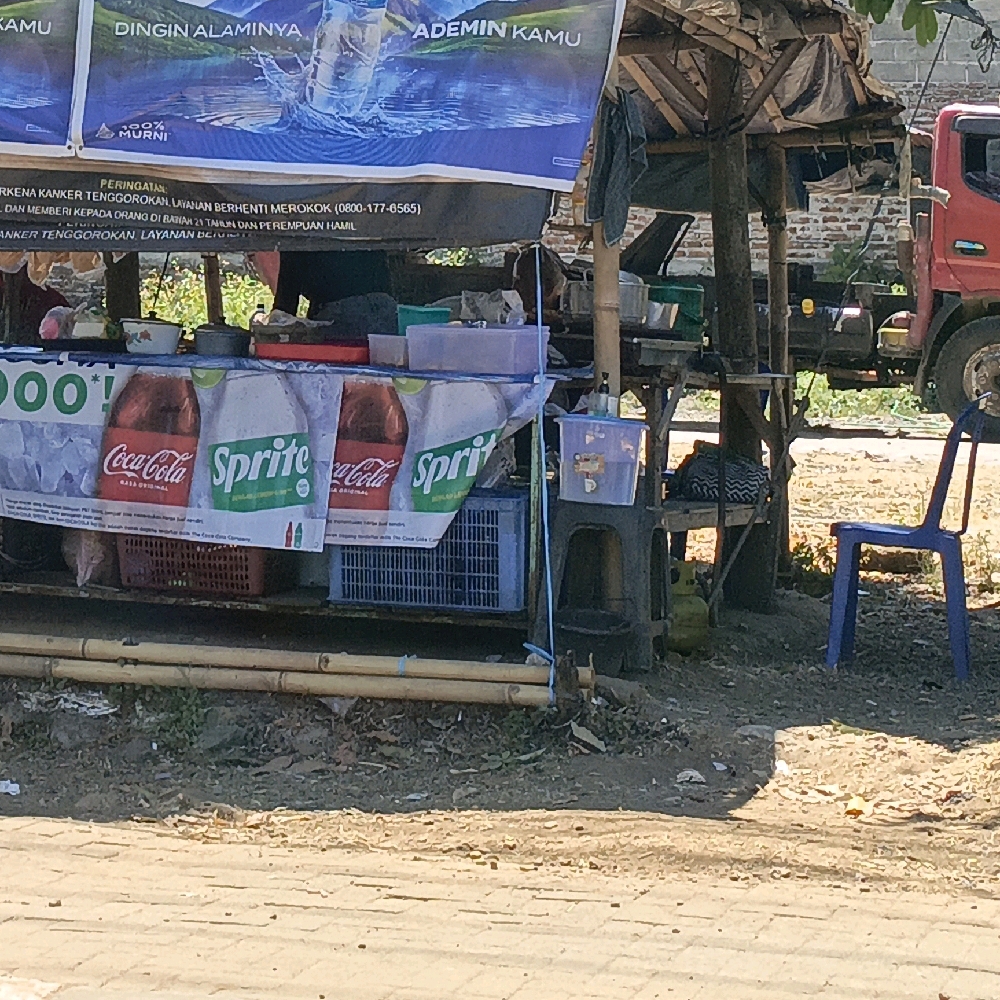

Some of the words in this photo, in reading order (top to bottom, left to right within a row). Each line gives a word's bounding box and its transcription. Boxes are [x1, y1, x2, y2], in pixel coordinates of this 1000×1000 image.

[114, 22, 189, 38] DINGIN
[192, 21, 303, 39] ALAMINYA
[412, 19, 508, 40] ADEMIN
[511, 26, 582, 47] KAMU
[118, 130, 168, 142] MURNI
[38, 188, 83, 201] KANKER
[214, 202, 268, 215] BERHENTI
[270, 203, 332, 215] MEROKOK
[334, 202, 422, 216] (0800-177-6565)
[4, 203, 25, 213] DAN
[27, 205, 72, 216] MEMBERI
[73, 207, 113, 219] KEPADA
[114, 210, 149, 222] ORANG
[150, 213, 162, 223] DI
[259, 221, 324, 231] PEREMPUAN
[326, 221, 357, 231] HAMIL
[140, 229, 199, 240] LAYANAN
[213, 437, 309, 493] Sprite
